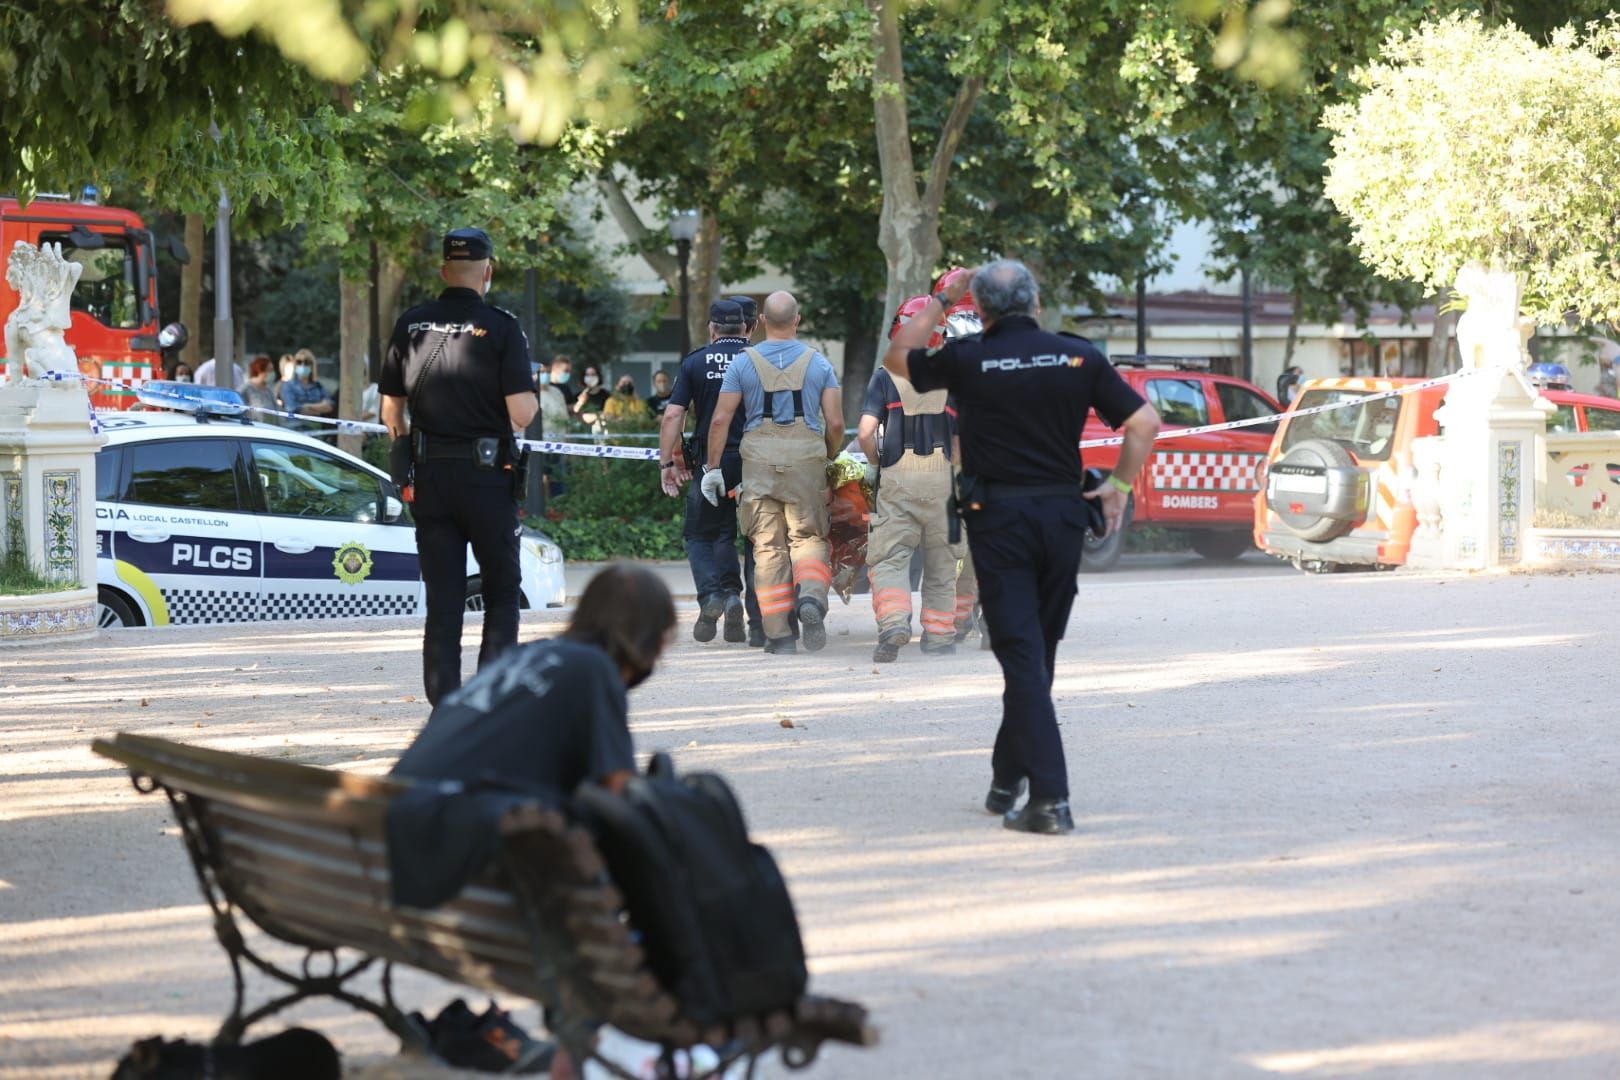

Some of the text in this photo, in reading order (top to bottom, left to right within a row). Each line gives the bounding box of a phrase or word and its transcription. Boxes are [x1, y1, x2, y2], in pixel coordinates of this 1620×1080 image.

[408, 322, 475, 334] POLICIA
[981, 354, 1070, 372] POLICIA
[1162, 495, 1218, 509] BOMBERS
[133, 514, 168, 523] LOCAL
[170, 517, 229, 527] CASTELLON
[172, 543, 253, 571] PLCS
